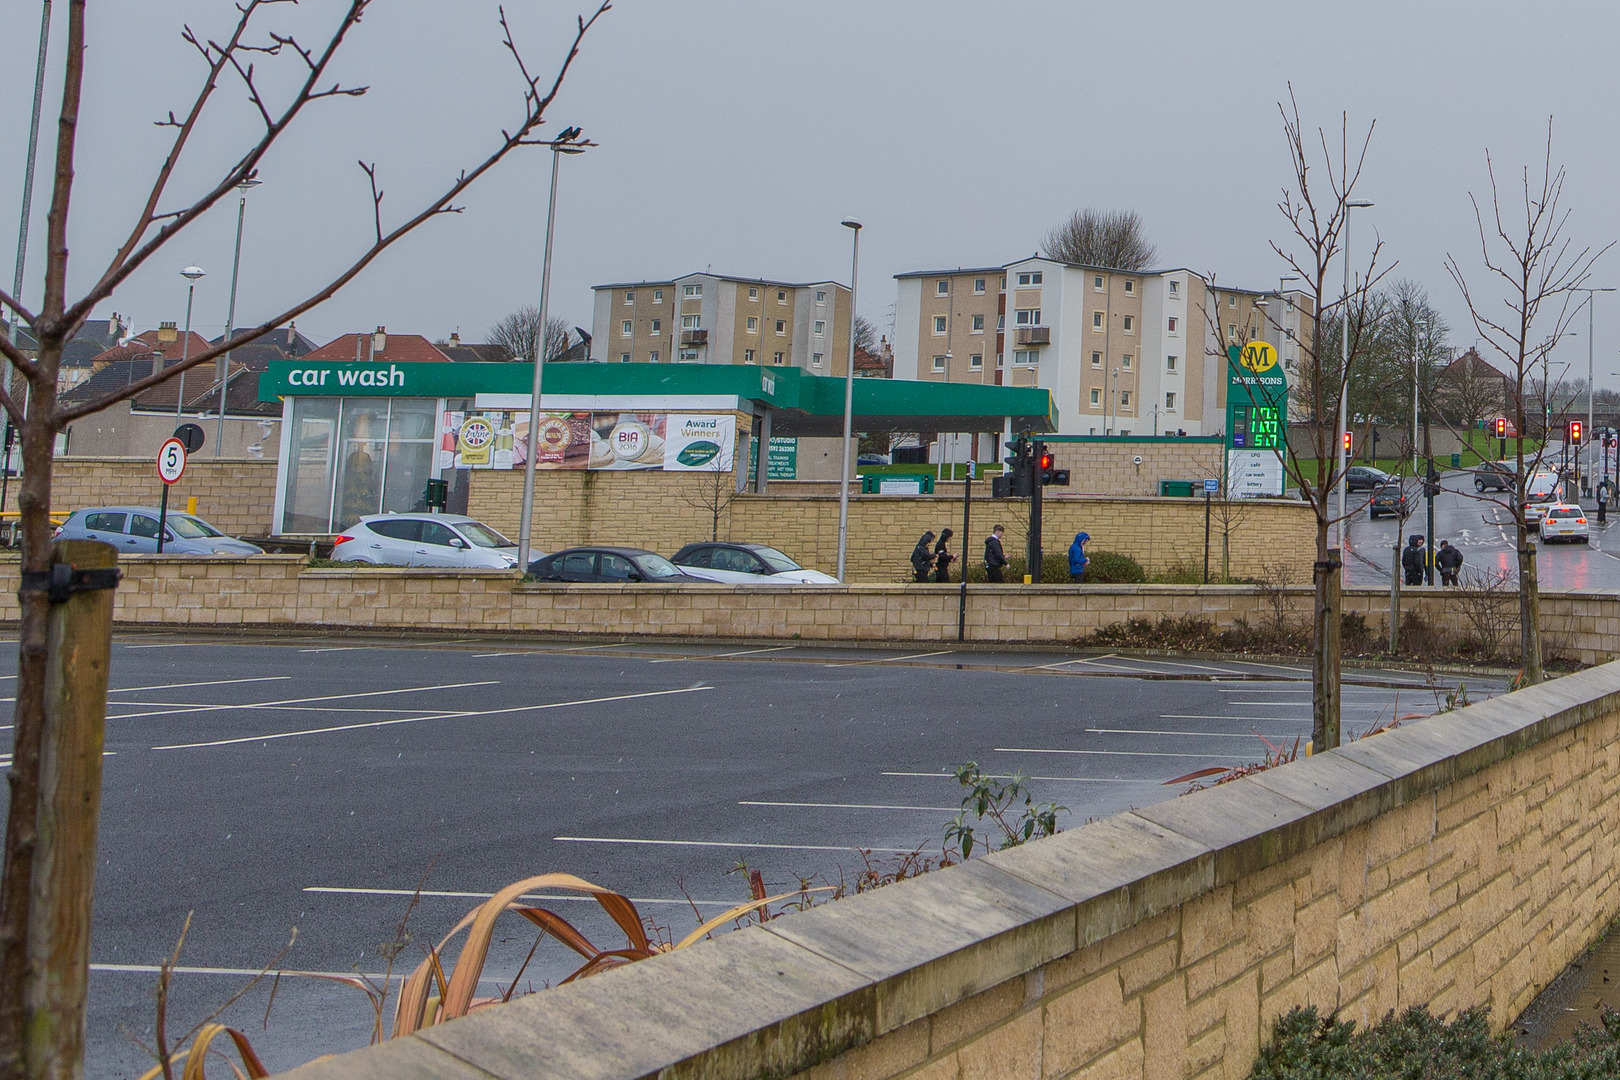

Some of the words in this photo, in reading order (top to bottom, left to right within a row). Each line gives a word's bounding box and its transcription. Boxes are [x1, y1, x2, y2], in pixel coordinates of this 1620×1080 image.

[1247, 347, 1270, 366] M
[288, 369, 331, 386] car
[337, 364, 405, 387] wash
[681, 428, 720, 438] Winners
[686, 420, 717, 428] Award
[167, 446, 177, 468] 5
